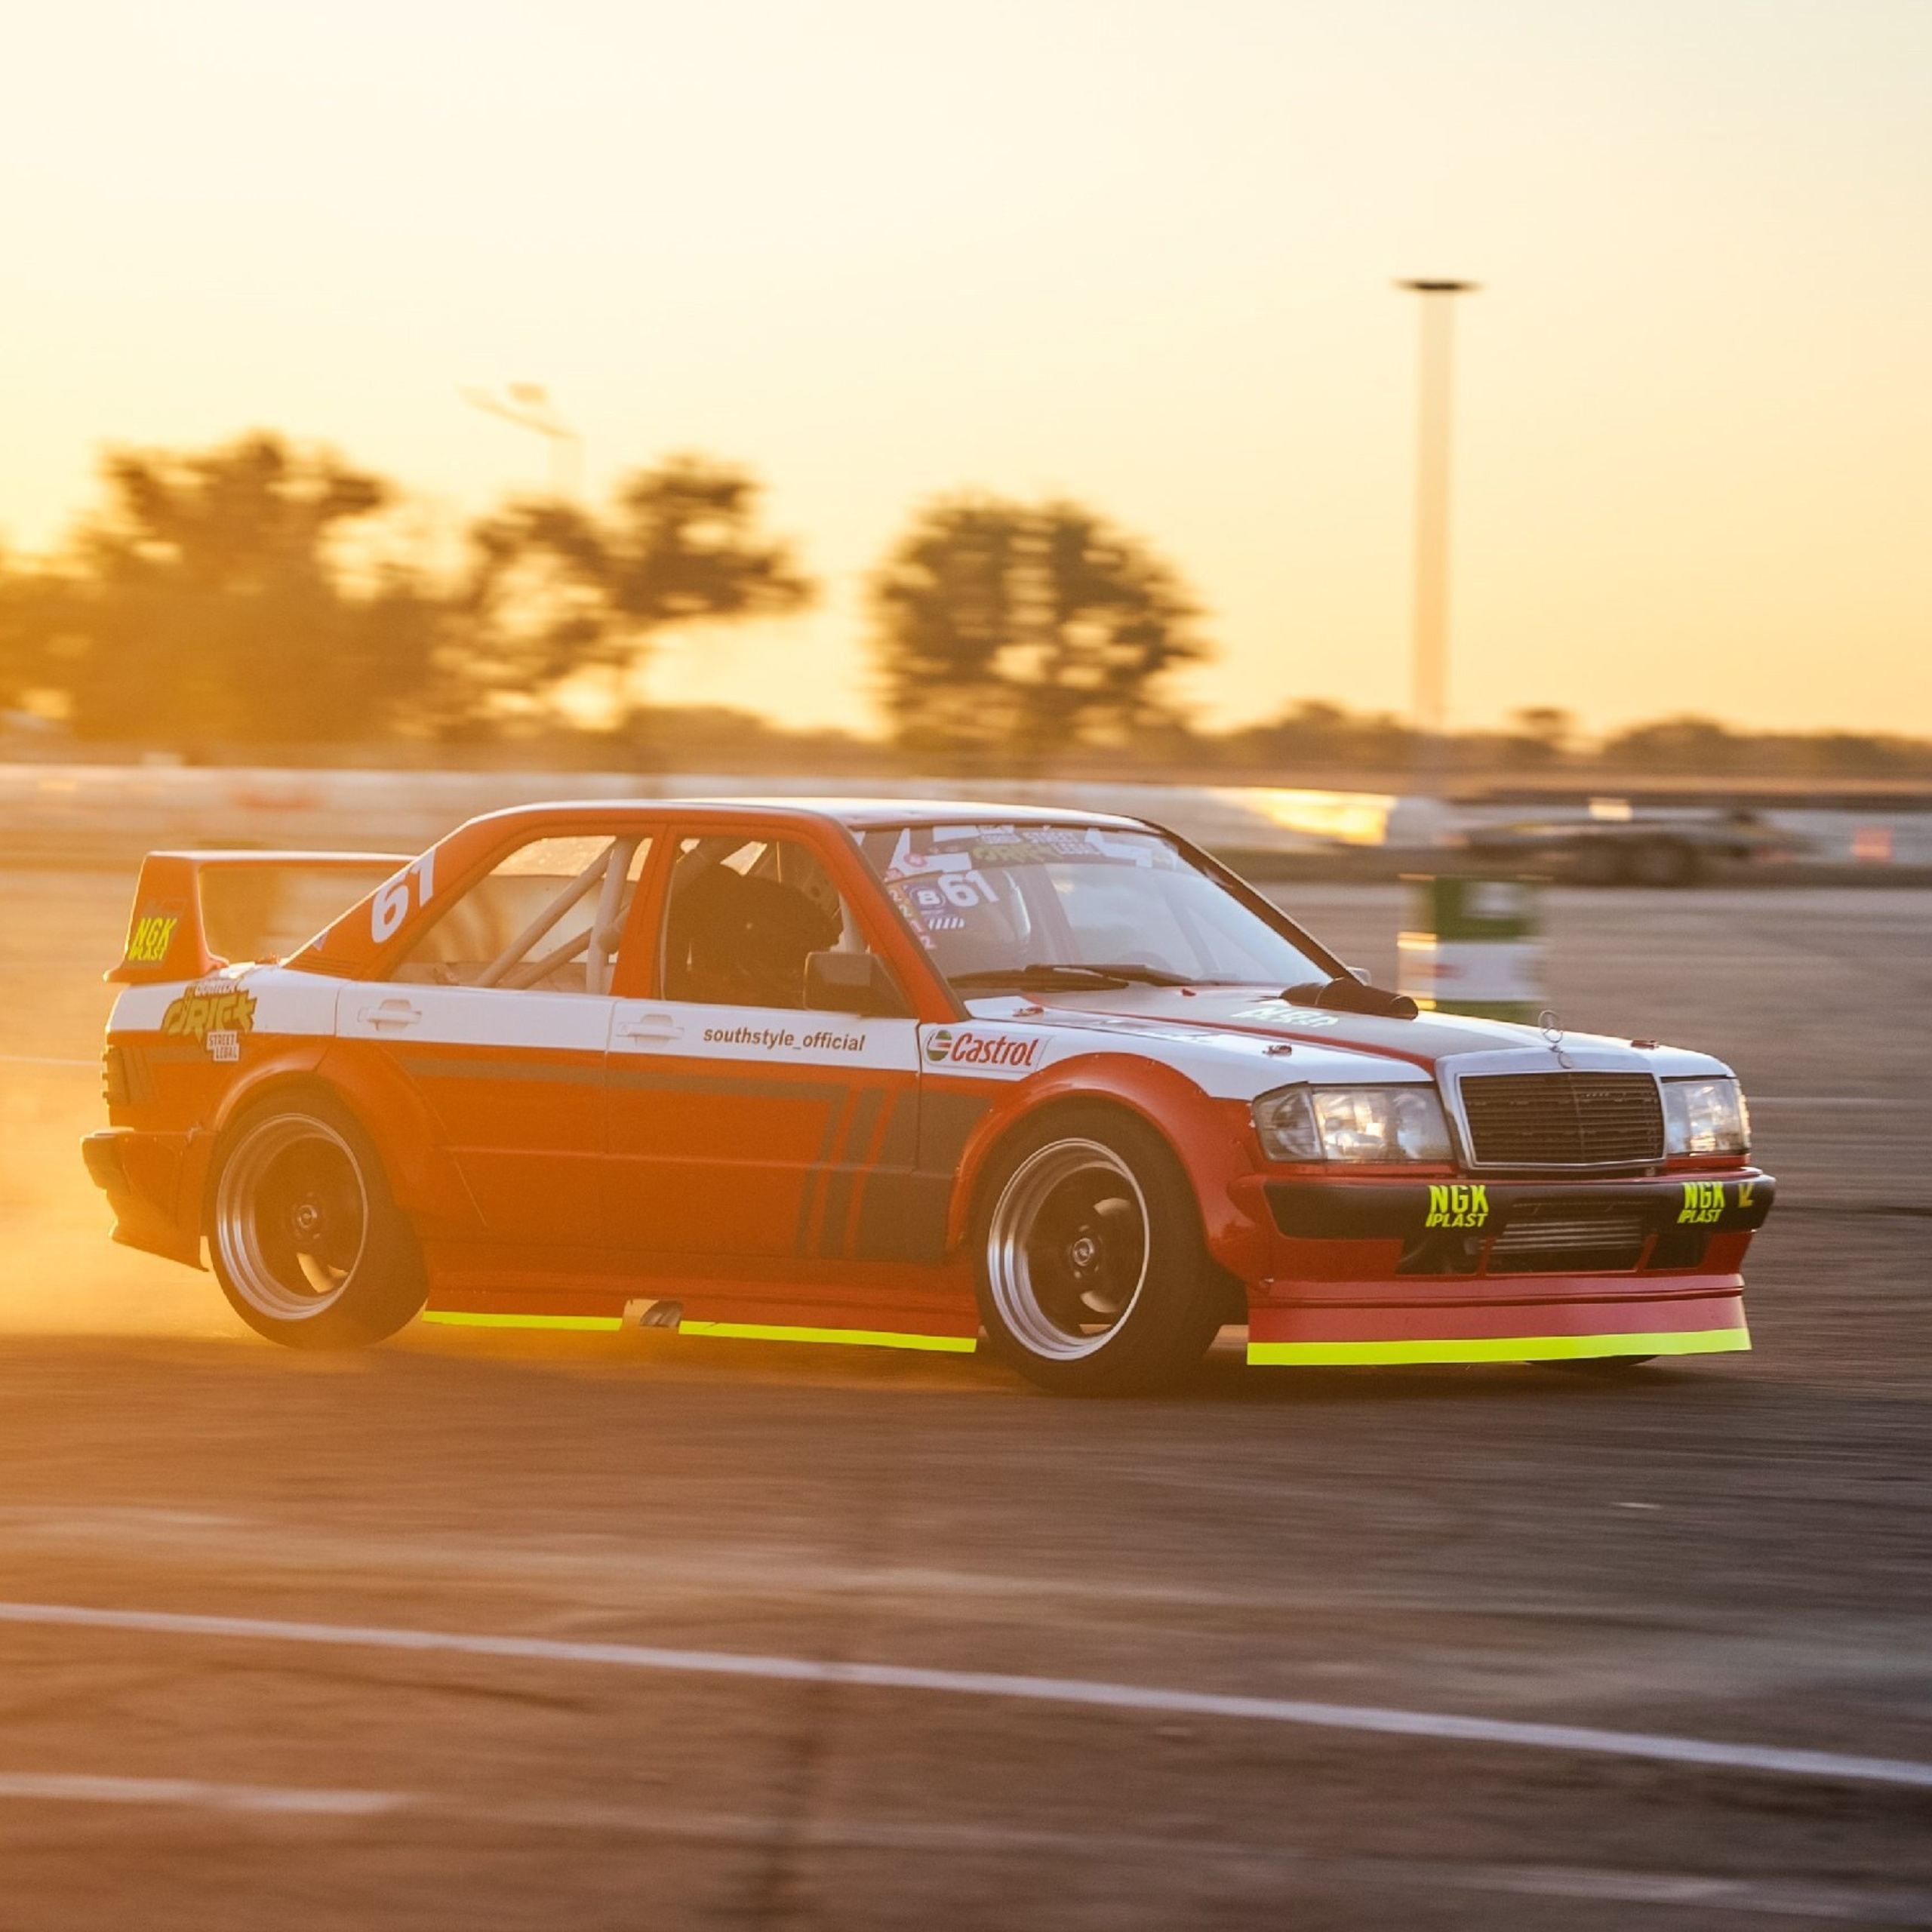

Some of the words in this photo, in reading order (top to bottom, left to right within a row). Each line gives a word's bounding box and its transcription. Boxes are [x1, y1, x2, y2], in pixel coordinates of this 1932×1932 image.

[371, 850, 435, 943] 61
[938, 869, 998, 907] 61
[135, 917, 177, 946] NGK
[703, 1027, 866, 1051] southstyle_official
[951, 1032, 1038, 1066] Castrol
[1428, 1185, 1489, 1214] NGK
[1682, 1182, 1726, 1209] NGK
